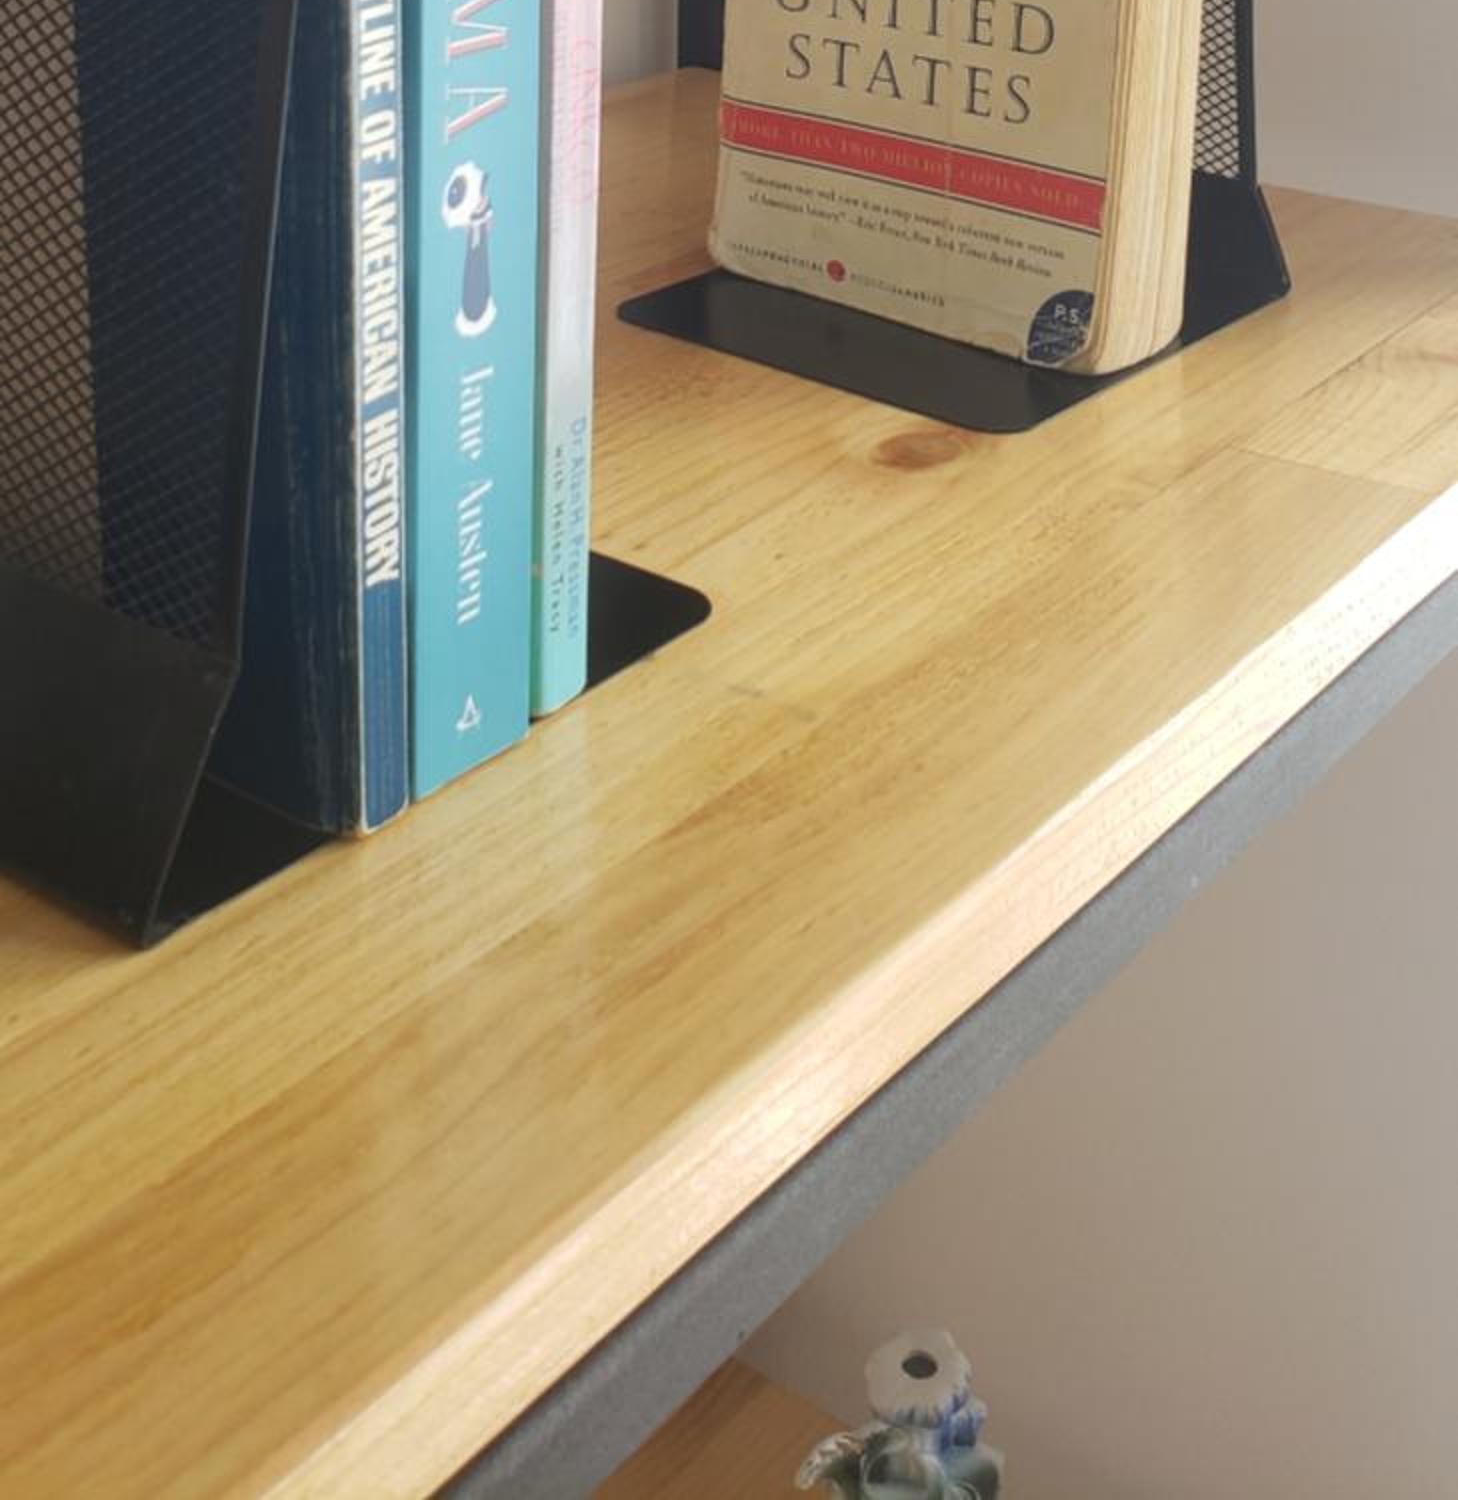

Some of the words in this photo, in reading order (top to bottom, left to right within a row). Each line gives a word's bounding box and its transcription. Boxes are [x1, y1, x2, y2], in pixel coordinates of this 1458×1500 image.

[784, 33, 1033, 126] STATES
[359, 114, 397, 169] OF
[361, 179, 399, 402] AMERICAN
[456, 366, 494, 461] Jane
[363, 410, 401, 587] HISTORY
[455, 478, 494, 625] Austen
